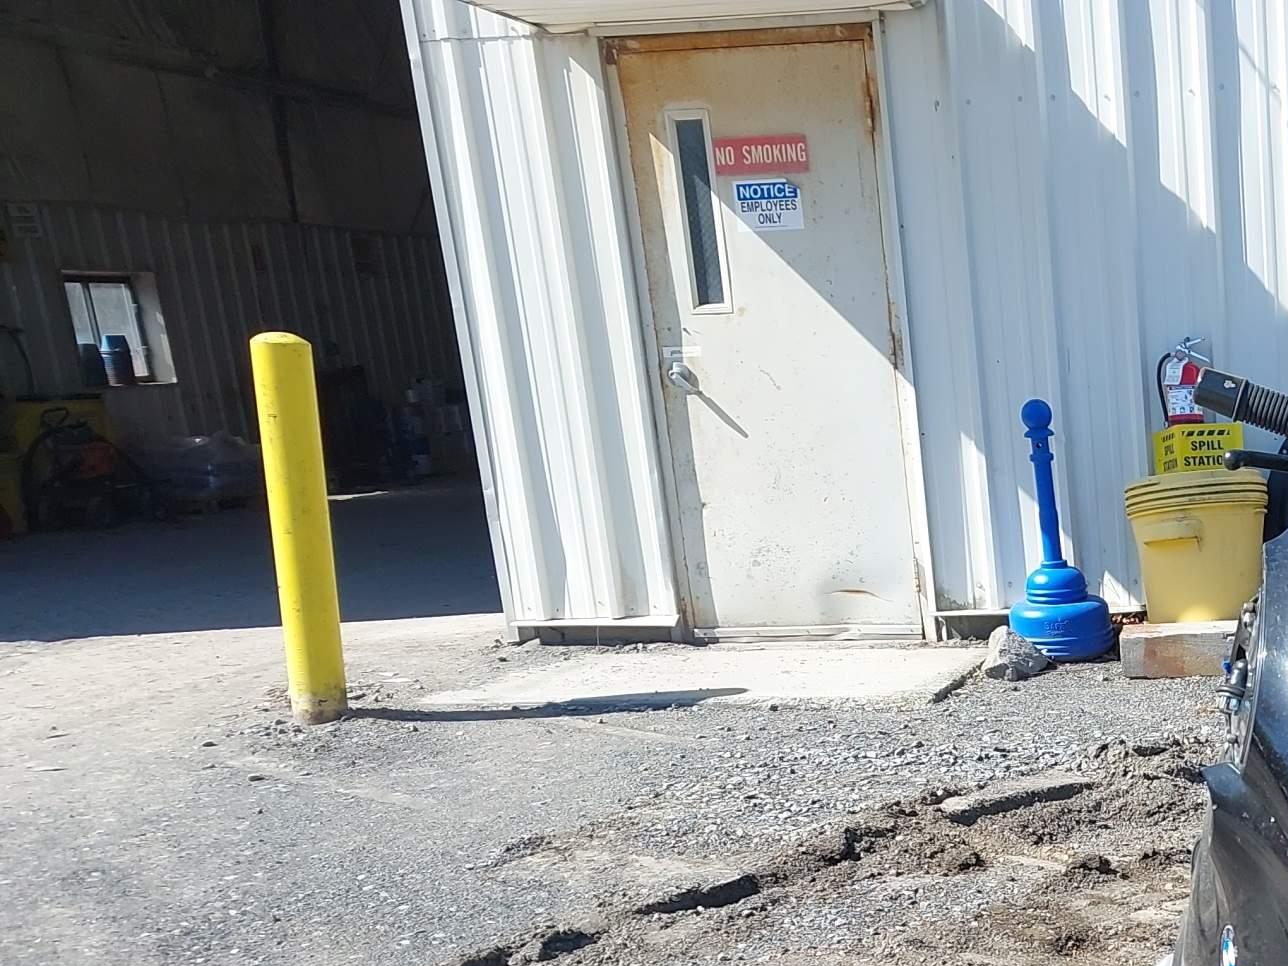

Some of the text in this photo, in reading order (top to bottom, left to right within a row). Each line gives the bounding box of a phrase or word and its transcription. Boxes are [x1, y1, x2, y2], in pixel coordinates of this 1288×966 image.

[714, 143, 806, 166] NO SMOKING
[739, 184, 795, 198] NOTICE
[741, 200, 797, 212] EMPLOYEES
[758, 213, 782, 224] ONLY
[1190, 439, 1224, 451] SPILL
[1183, 454, 1223, 467] STATIO
